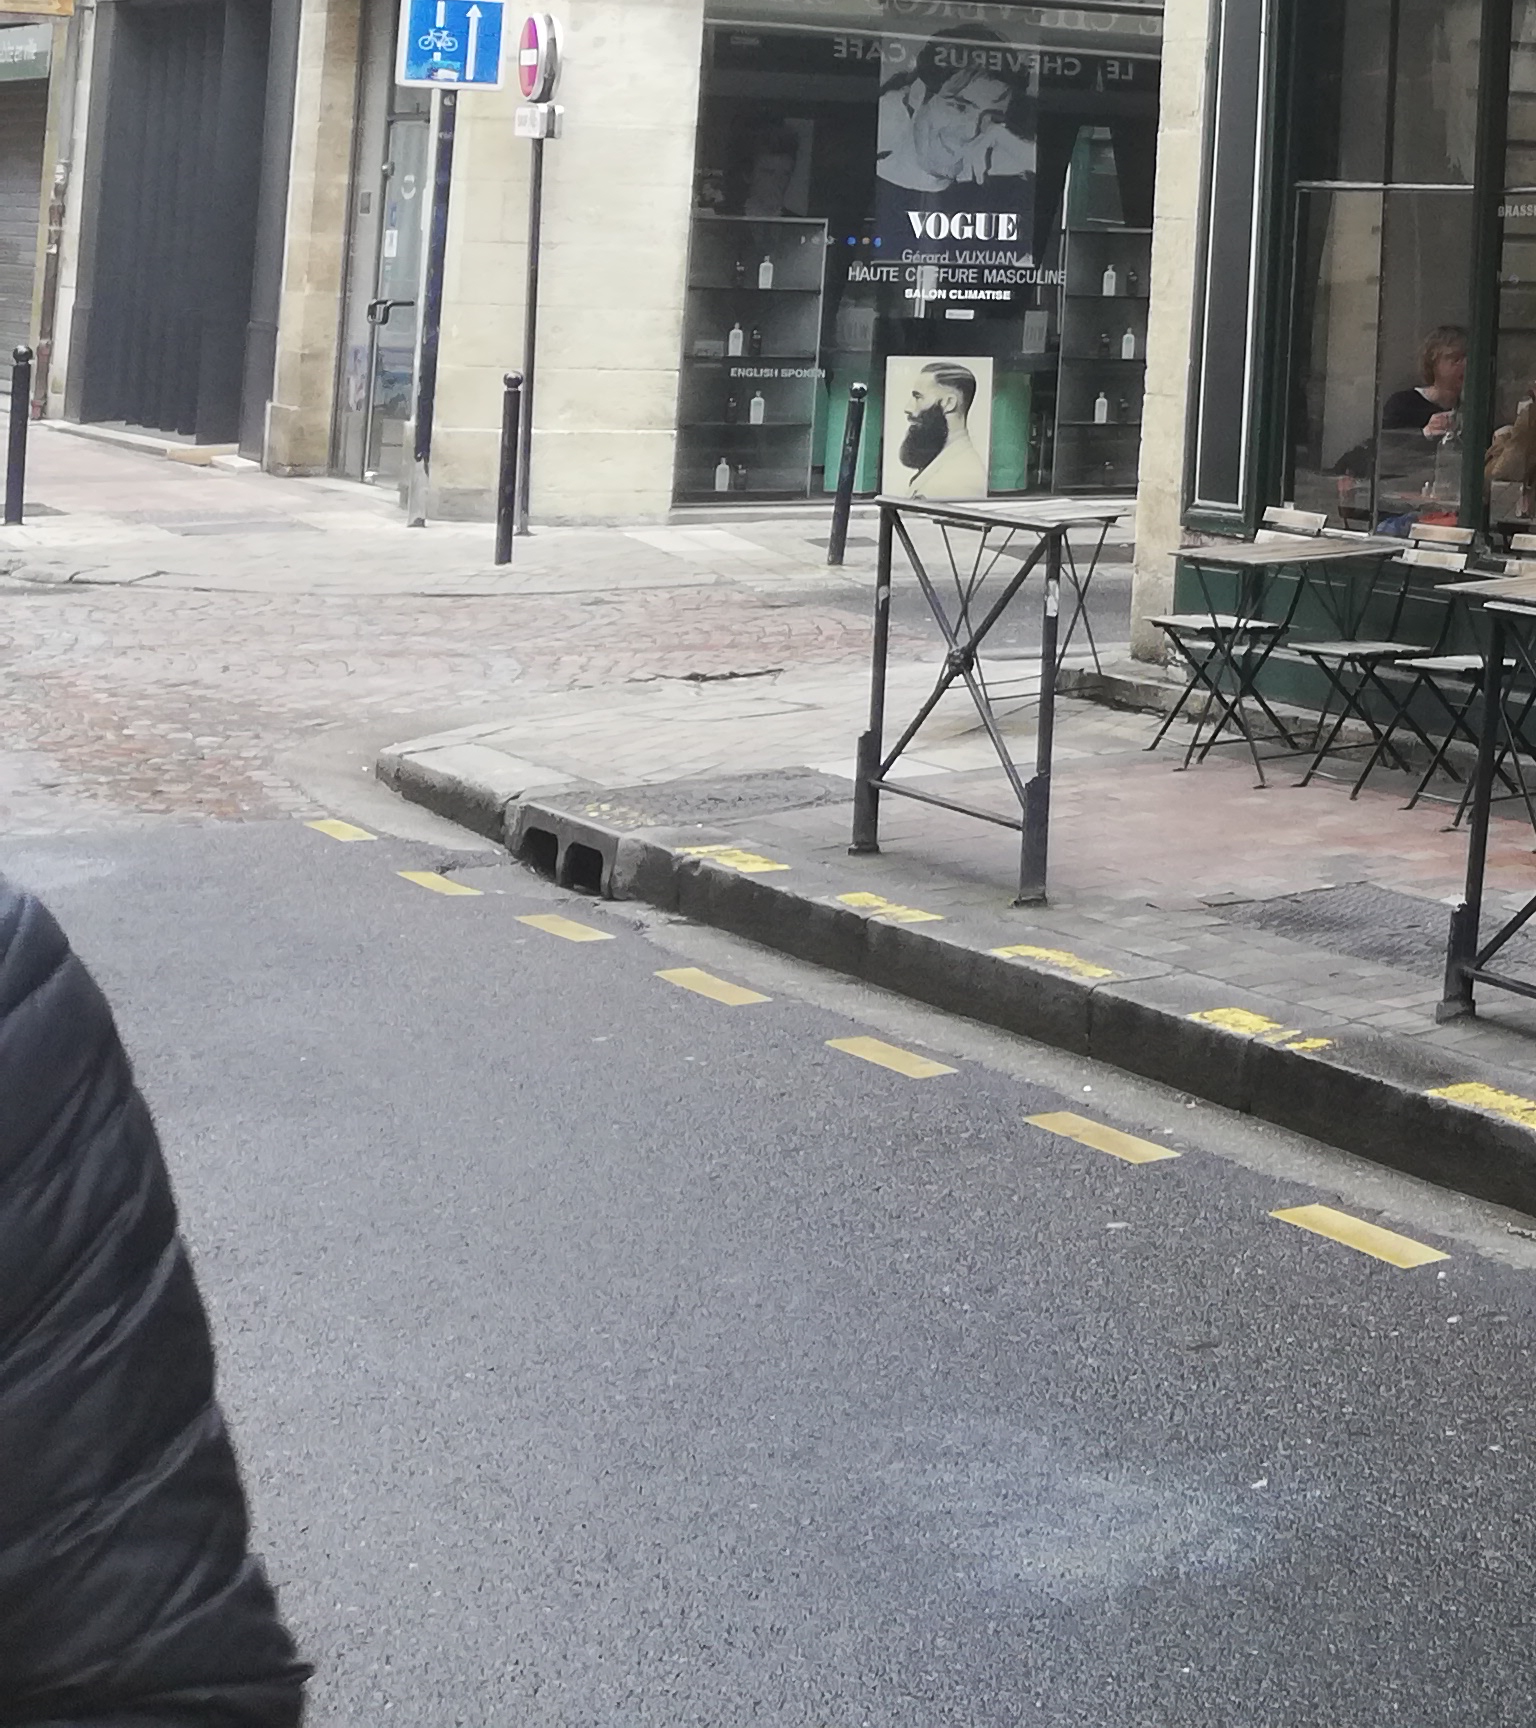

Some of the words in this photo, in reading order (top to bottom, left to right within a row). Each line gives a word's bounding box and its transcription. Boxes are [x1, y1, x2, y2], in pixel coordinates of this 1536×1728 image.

[906, 211, 1018, 241] VOGUE
[902, 248, 950, 264] Gérard
[955, 251, 1017, 265] VUXUAN
[848, 266, 899, 283] HAUTE
[983, 268, 1066, 285] MASCULINE
[905, 288, 947, 300] SALON
[730, 367, 778, 378] ENGLISH
[780, 368, 826, 379] SPOKEN
